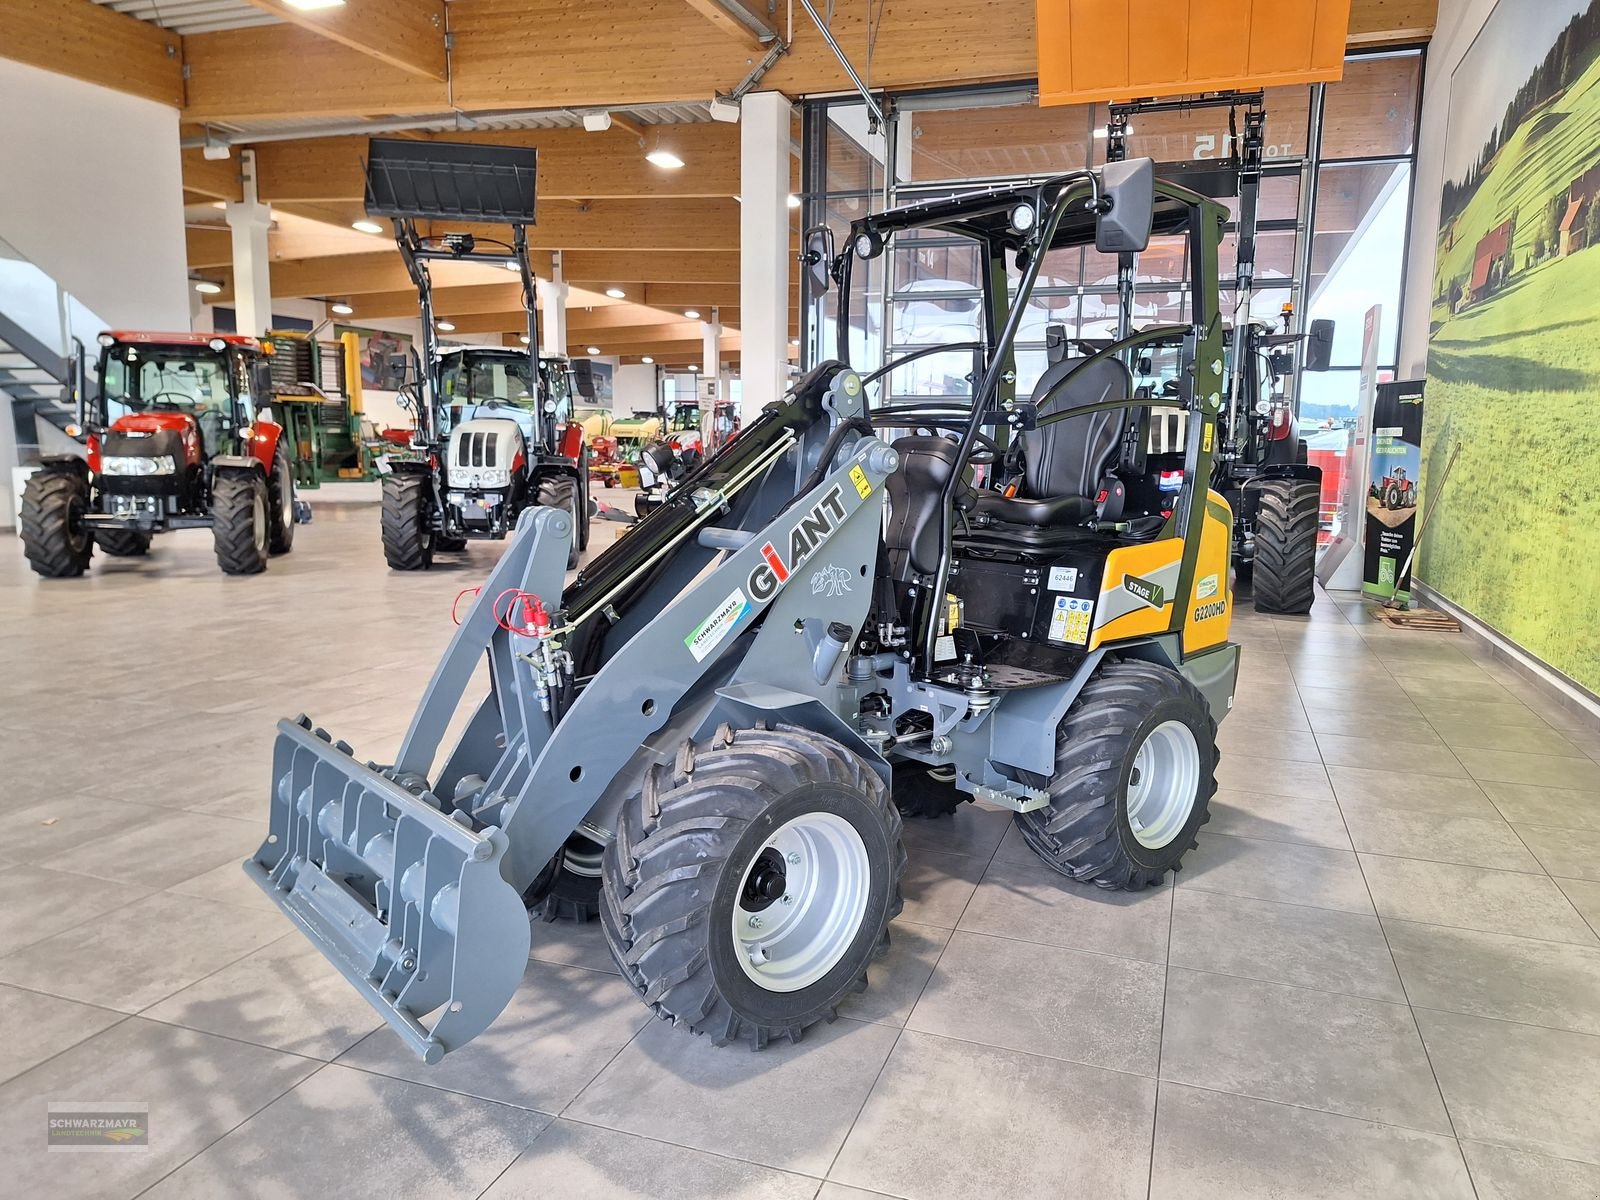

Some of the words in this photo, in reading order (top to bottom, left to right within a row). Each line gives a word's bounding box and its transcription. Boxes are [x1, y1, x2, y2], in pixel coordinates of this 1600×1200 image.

[1054, 574, 1074, 582] 62446
[1128, 581, 1150, 599] STAGE
[1151, 585, 1162, 602] V
[1194, 600, 1226, 623] G2200HD
[693, 600, 737, 646] SCHWARZMAYR
